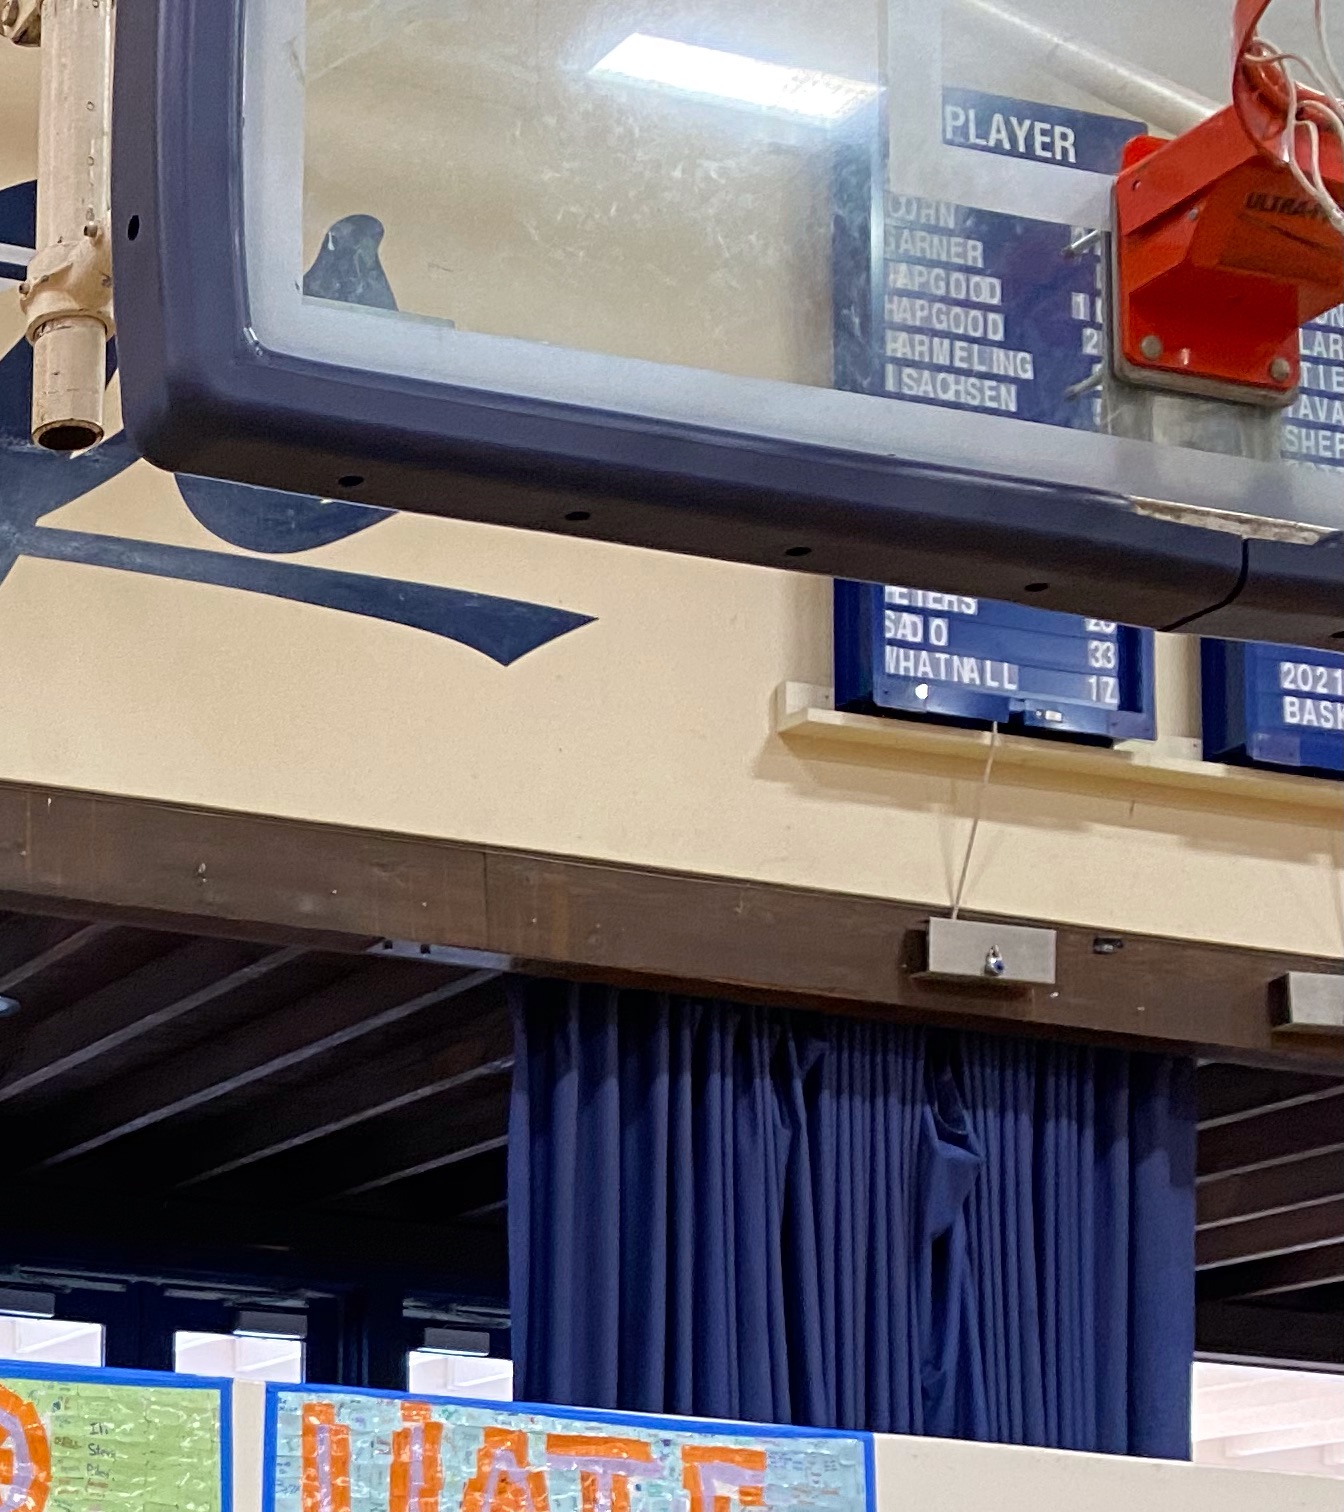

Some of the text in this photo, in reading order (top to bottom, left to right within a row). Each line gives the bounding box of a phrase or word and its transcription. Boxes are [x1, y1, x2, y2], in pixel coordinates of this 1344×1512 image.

[943, 104, 1078, 165] PLAYER
[885, 294, 1005, 342] HAPGOOD
[885, 328, 1035, 380] HARMELING
[884, 363, 1018, 412] ISACHSEN
[885, 644, 1019, 691] WHATNALL
[1087, 640, 1117, 669] 33
